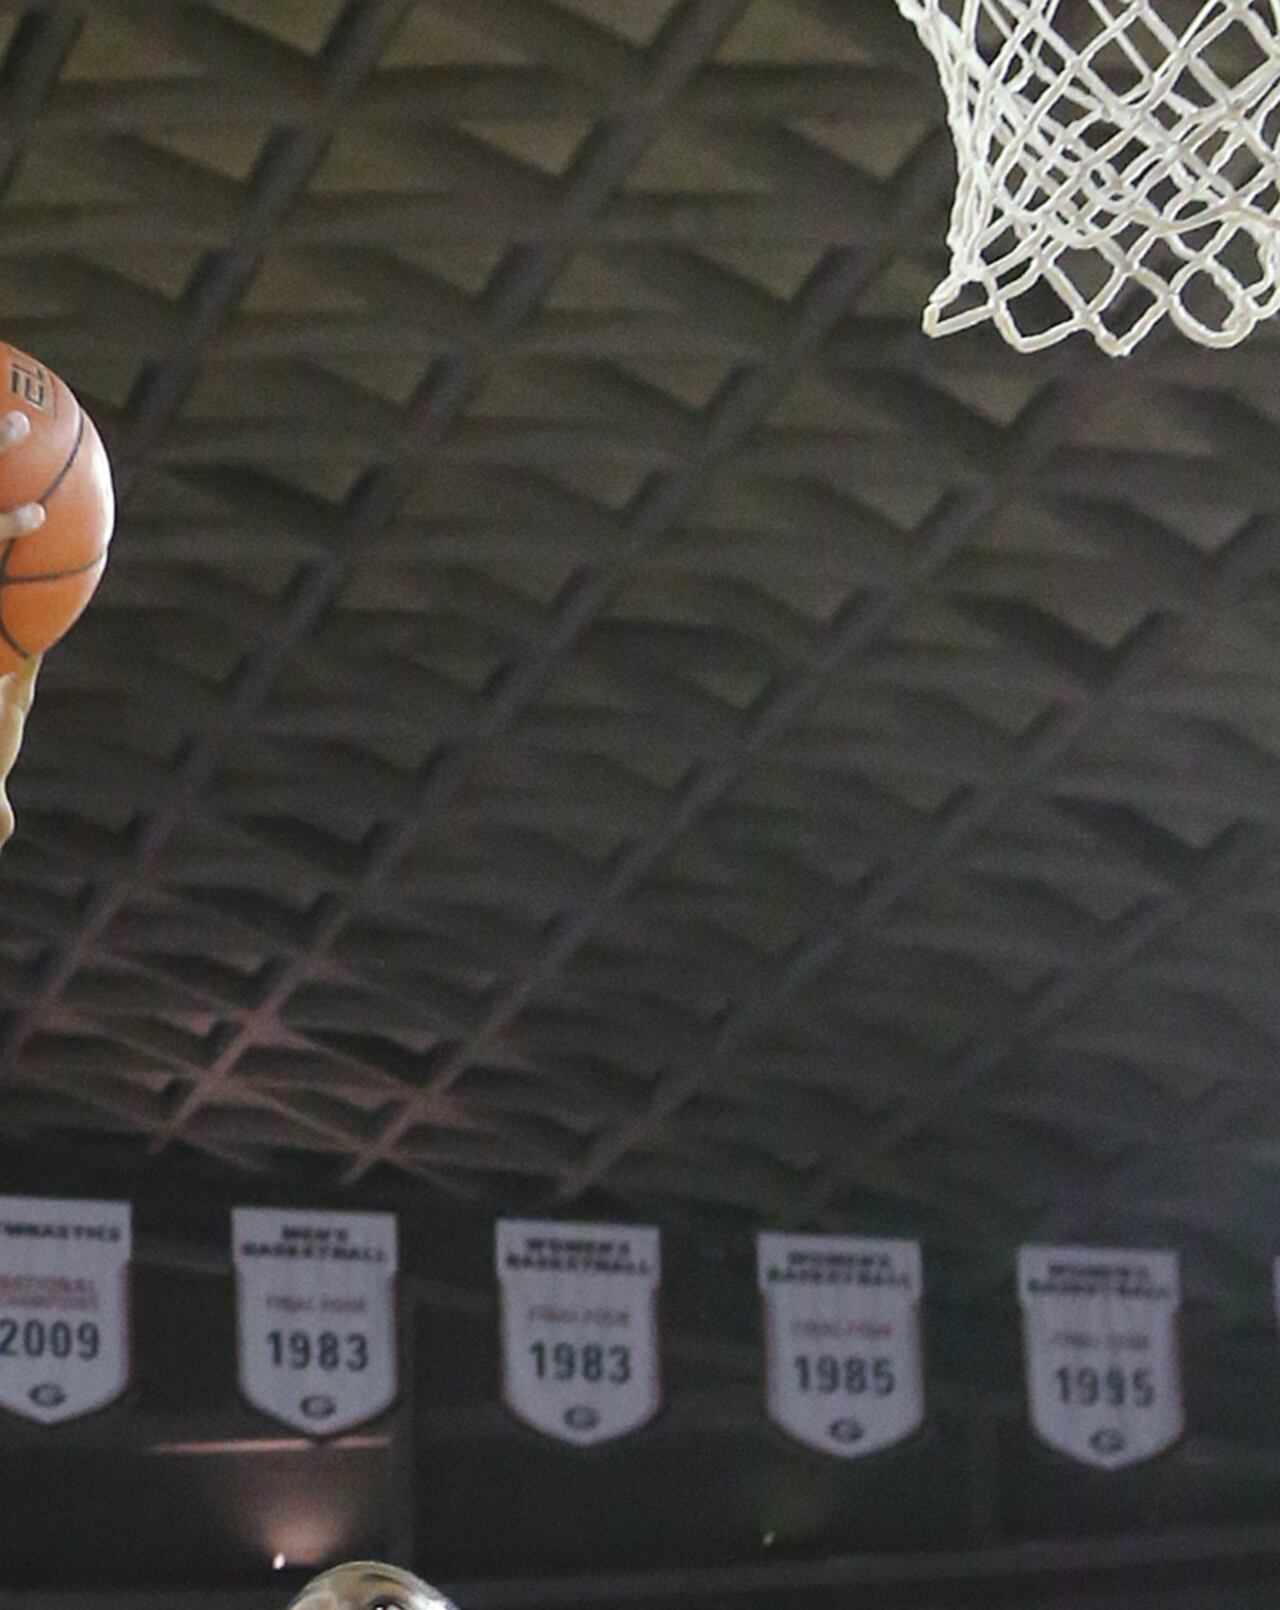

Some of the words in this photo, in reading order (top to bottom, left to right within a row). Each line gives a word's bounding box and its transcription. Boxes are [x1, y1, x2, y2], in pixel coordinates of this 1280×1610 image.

[267, 1330, 368, 1371] 1983
[530, 1341, 631, 1384] 1983
[795, 1354, 896, 1396] 1985
[1056, 1366, 1154, 1408] 1995
